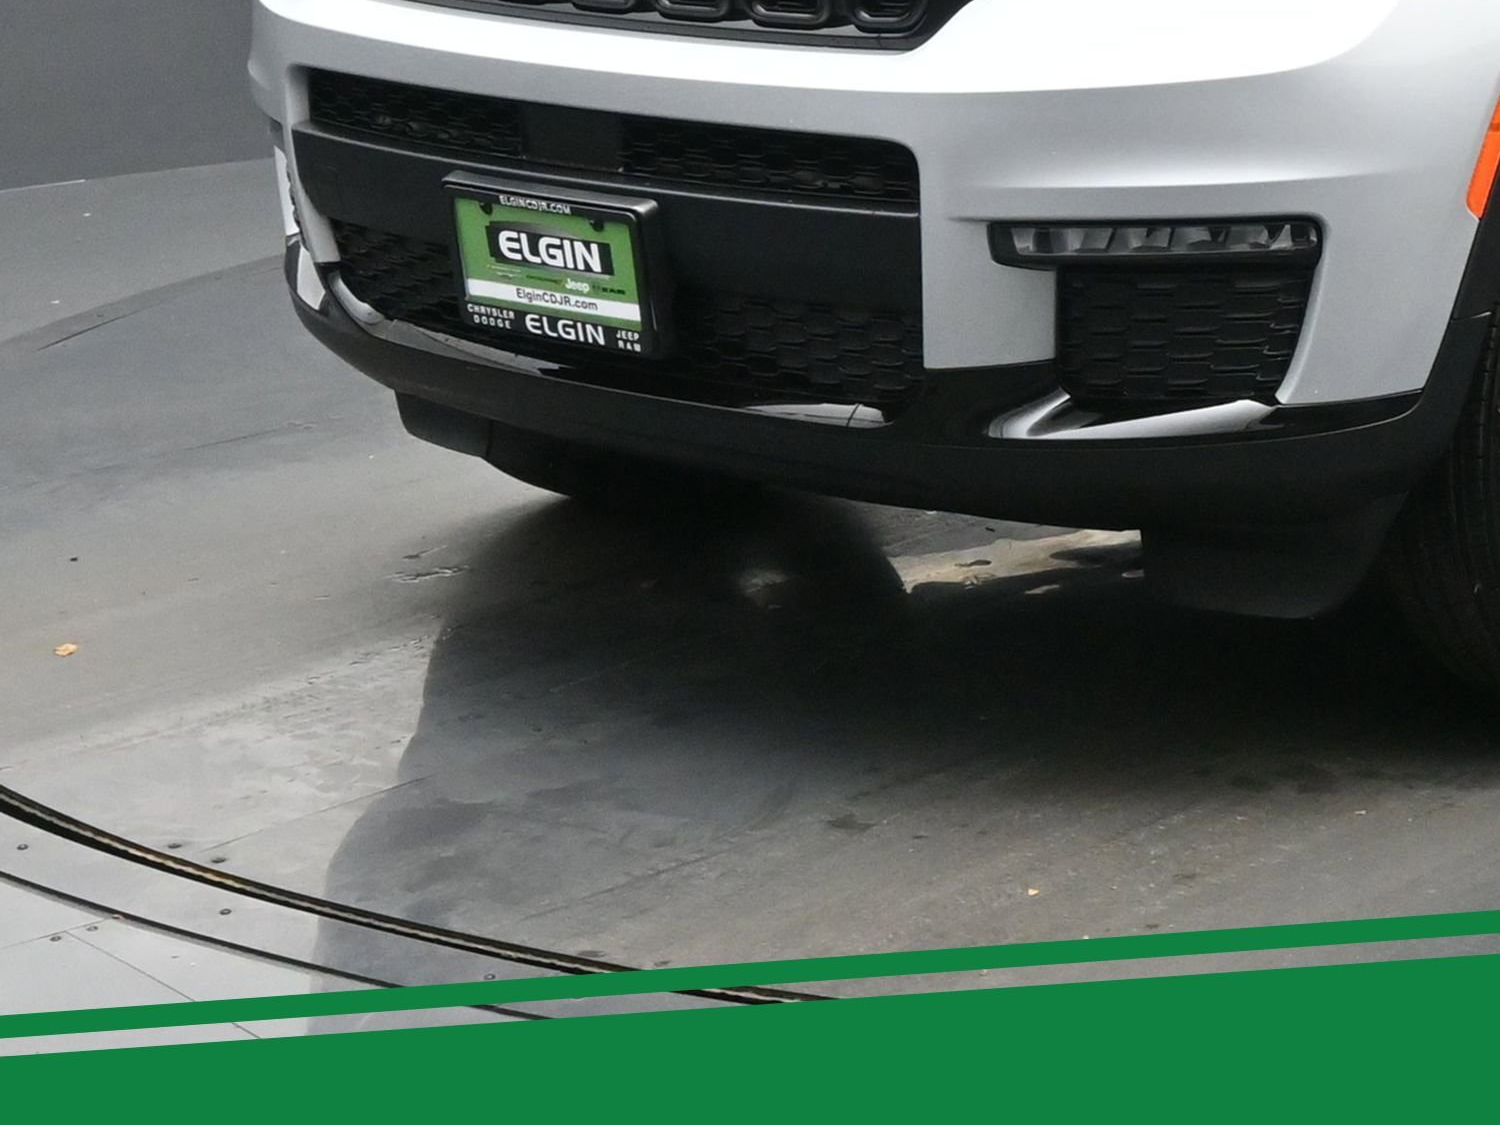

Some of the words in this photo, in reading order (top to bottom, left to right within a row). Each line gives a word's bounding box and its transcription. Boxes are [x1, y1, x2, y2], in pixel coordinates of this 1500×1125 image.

[498, 230, 602, 273] ELGIN
[565, 278, 590, 294] Jeep
[516, 287, 598, 311] ElginCDJR.com
[467, 303, 515, 319] CHRYSLER
[473, 314, 512, 329] DODGE
[525, 313, 605, 345] ELGIN
